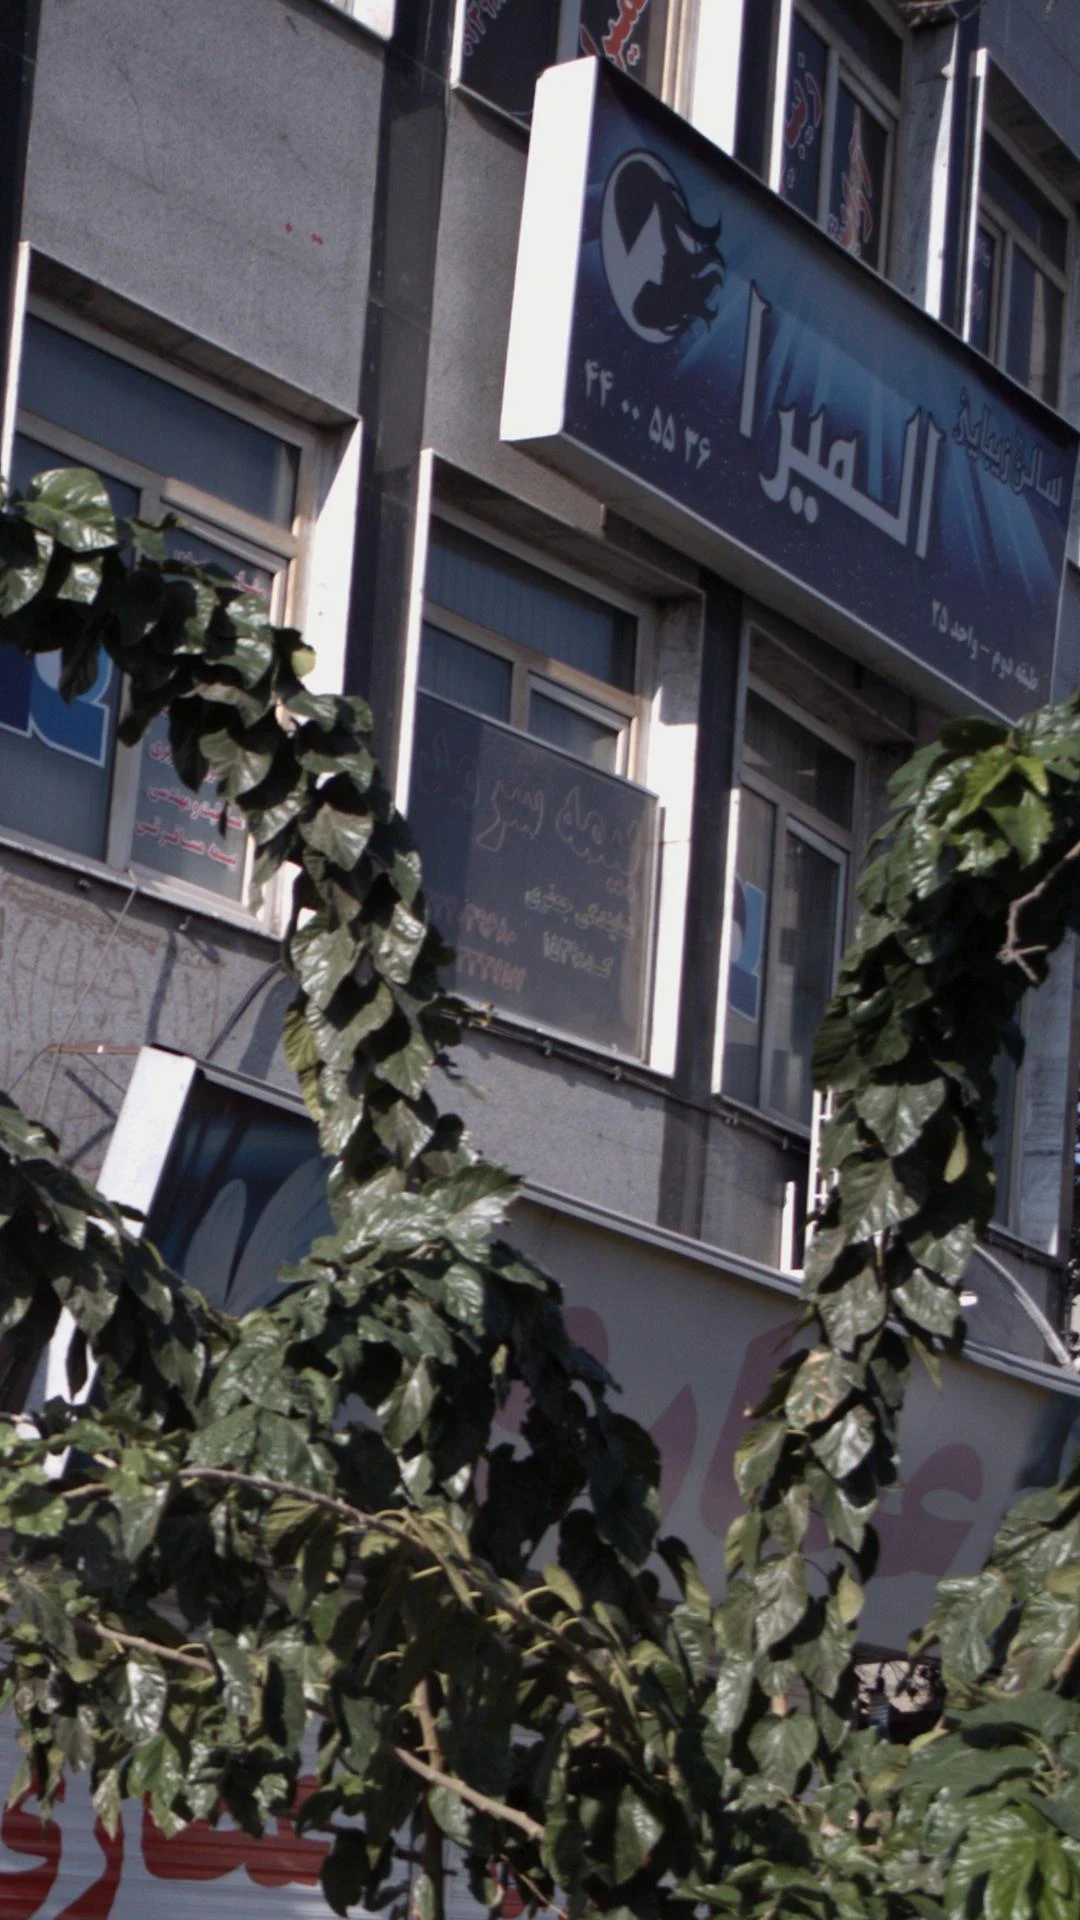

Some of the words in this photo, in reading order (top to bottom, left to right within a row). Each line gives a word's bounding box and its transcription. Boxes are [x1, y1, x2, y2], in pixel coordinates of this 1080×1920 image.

[739, 279, 946, 560] المیرا
[953, 386, 1012, 485] زیبایی
[1011, 428, 1064, 509] سالن
[950, 620, 978, 660] واحد
[991, 650, 1014, 679] دوم
[1015, 662, 1039, 692] طبقه
